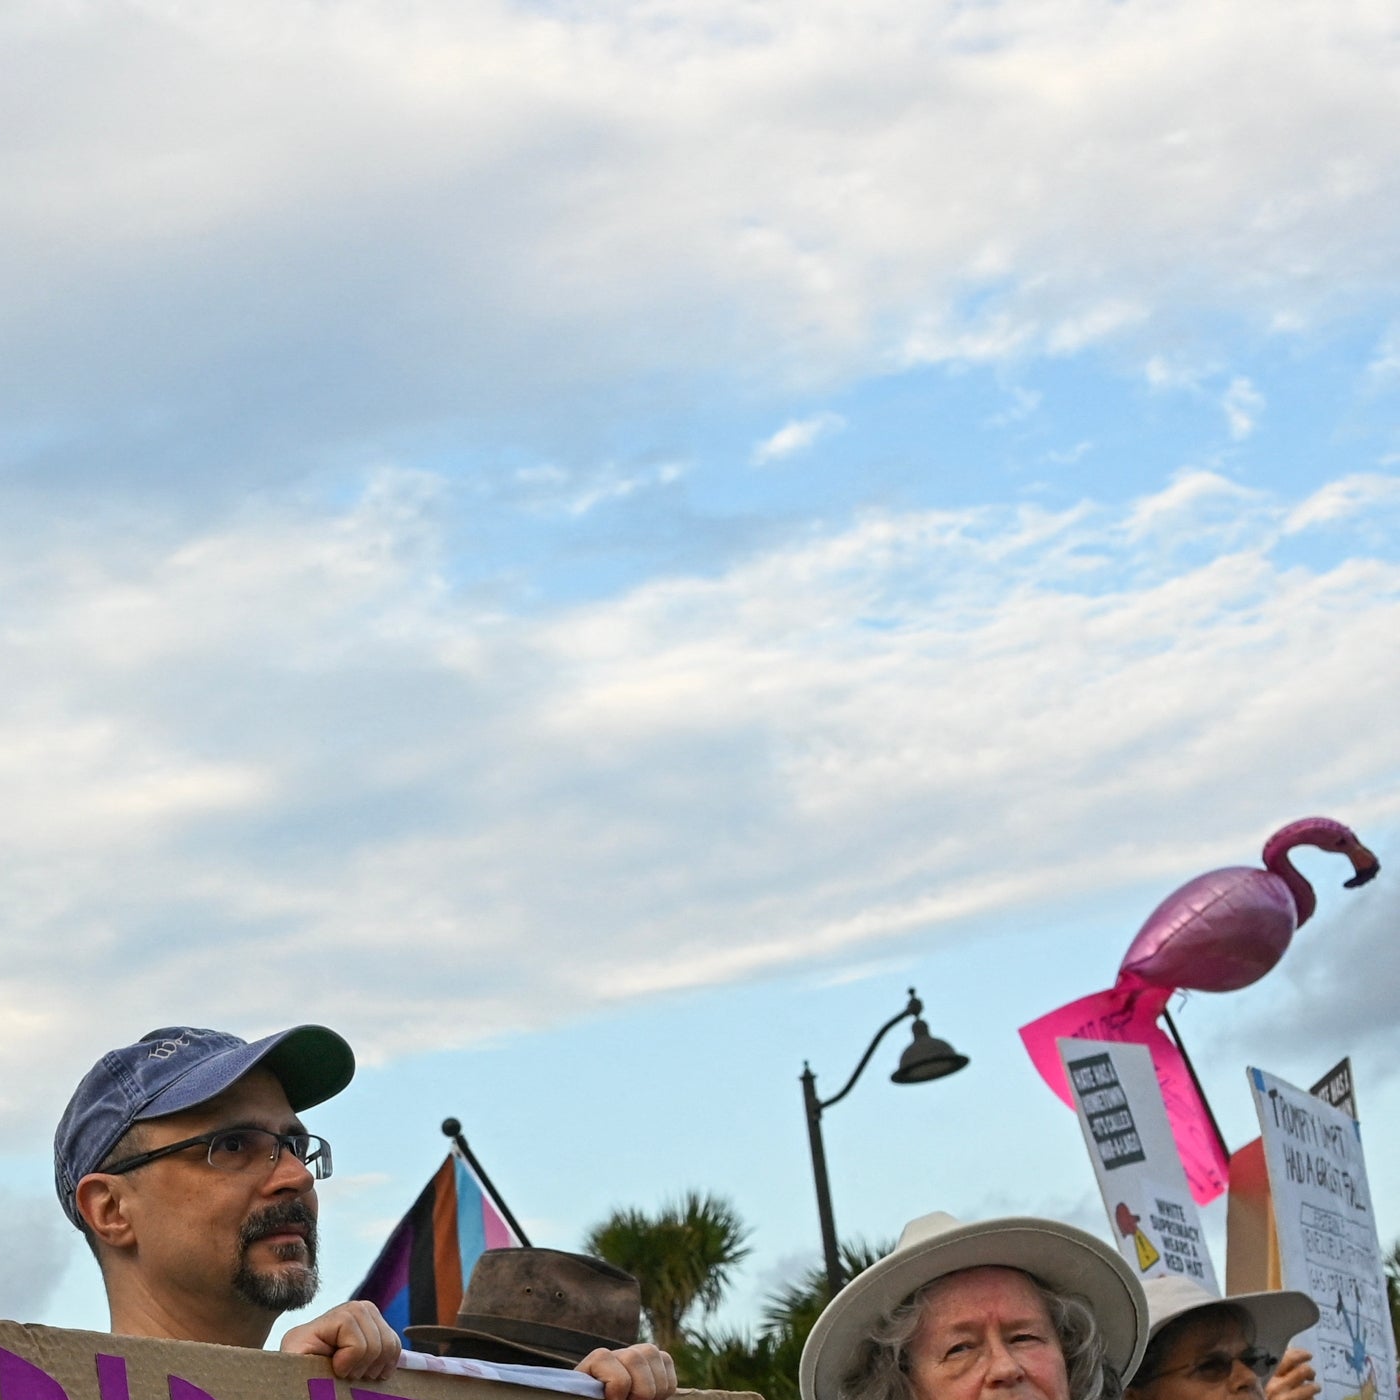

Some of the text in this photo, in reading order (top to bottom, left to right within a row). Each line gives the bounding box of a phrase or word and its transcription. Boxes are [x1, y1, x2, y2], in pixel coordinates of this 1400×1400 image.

[1155, 1197, 1186, 1223] WHITE
[1160, 1233, 1191, 1257] WEARS
[1164, 1251, 1185, 1274] RED
